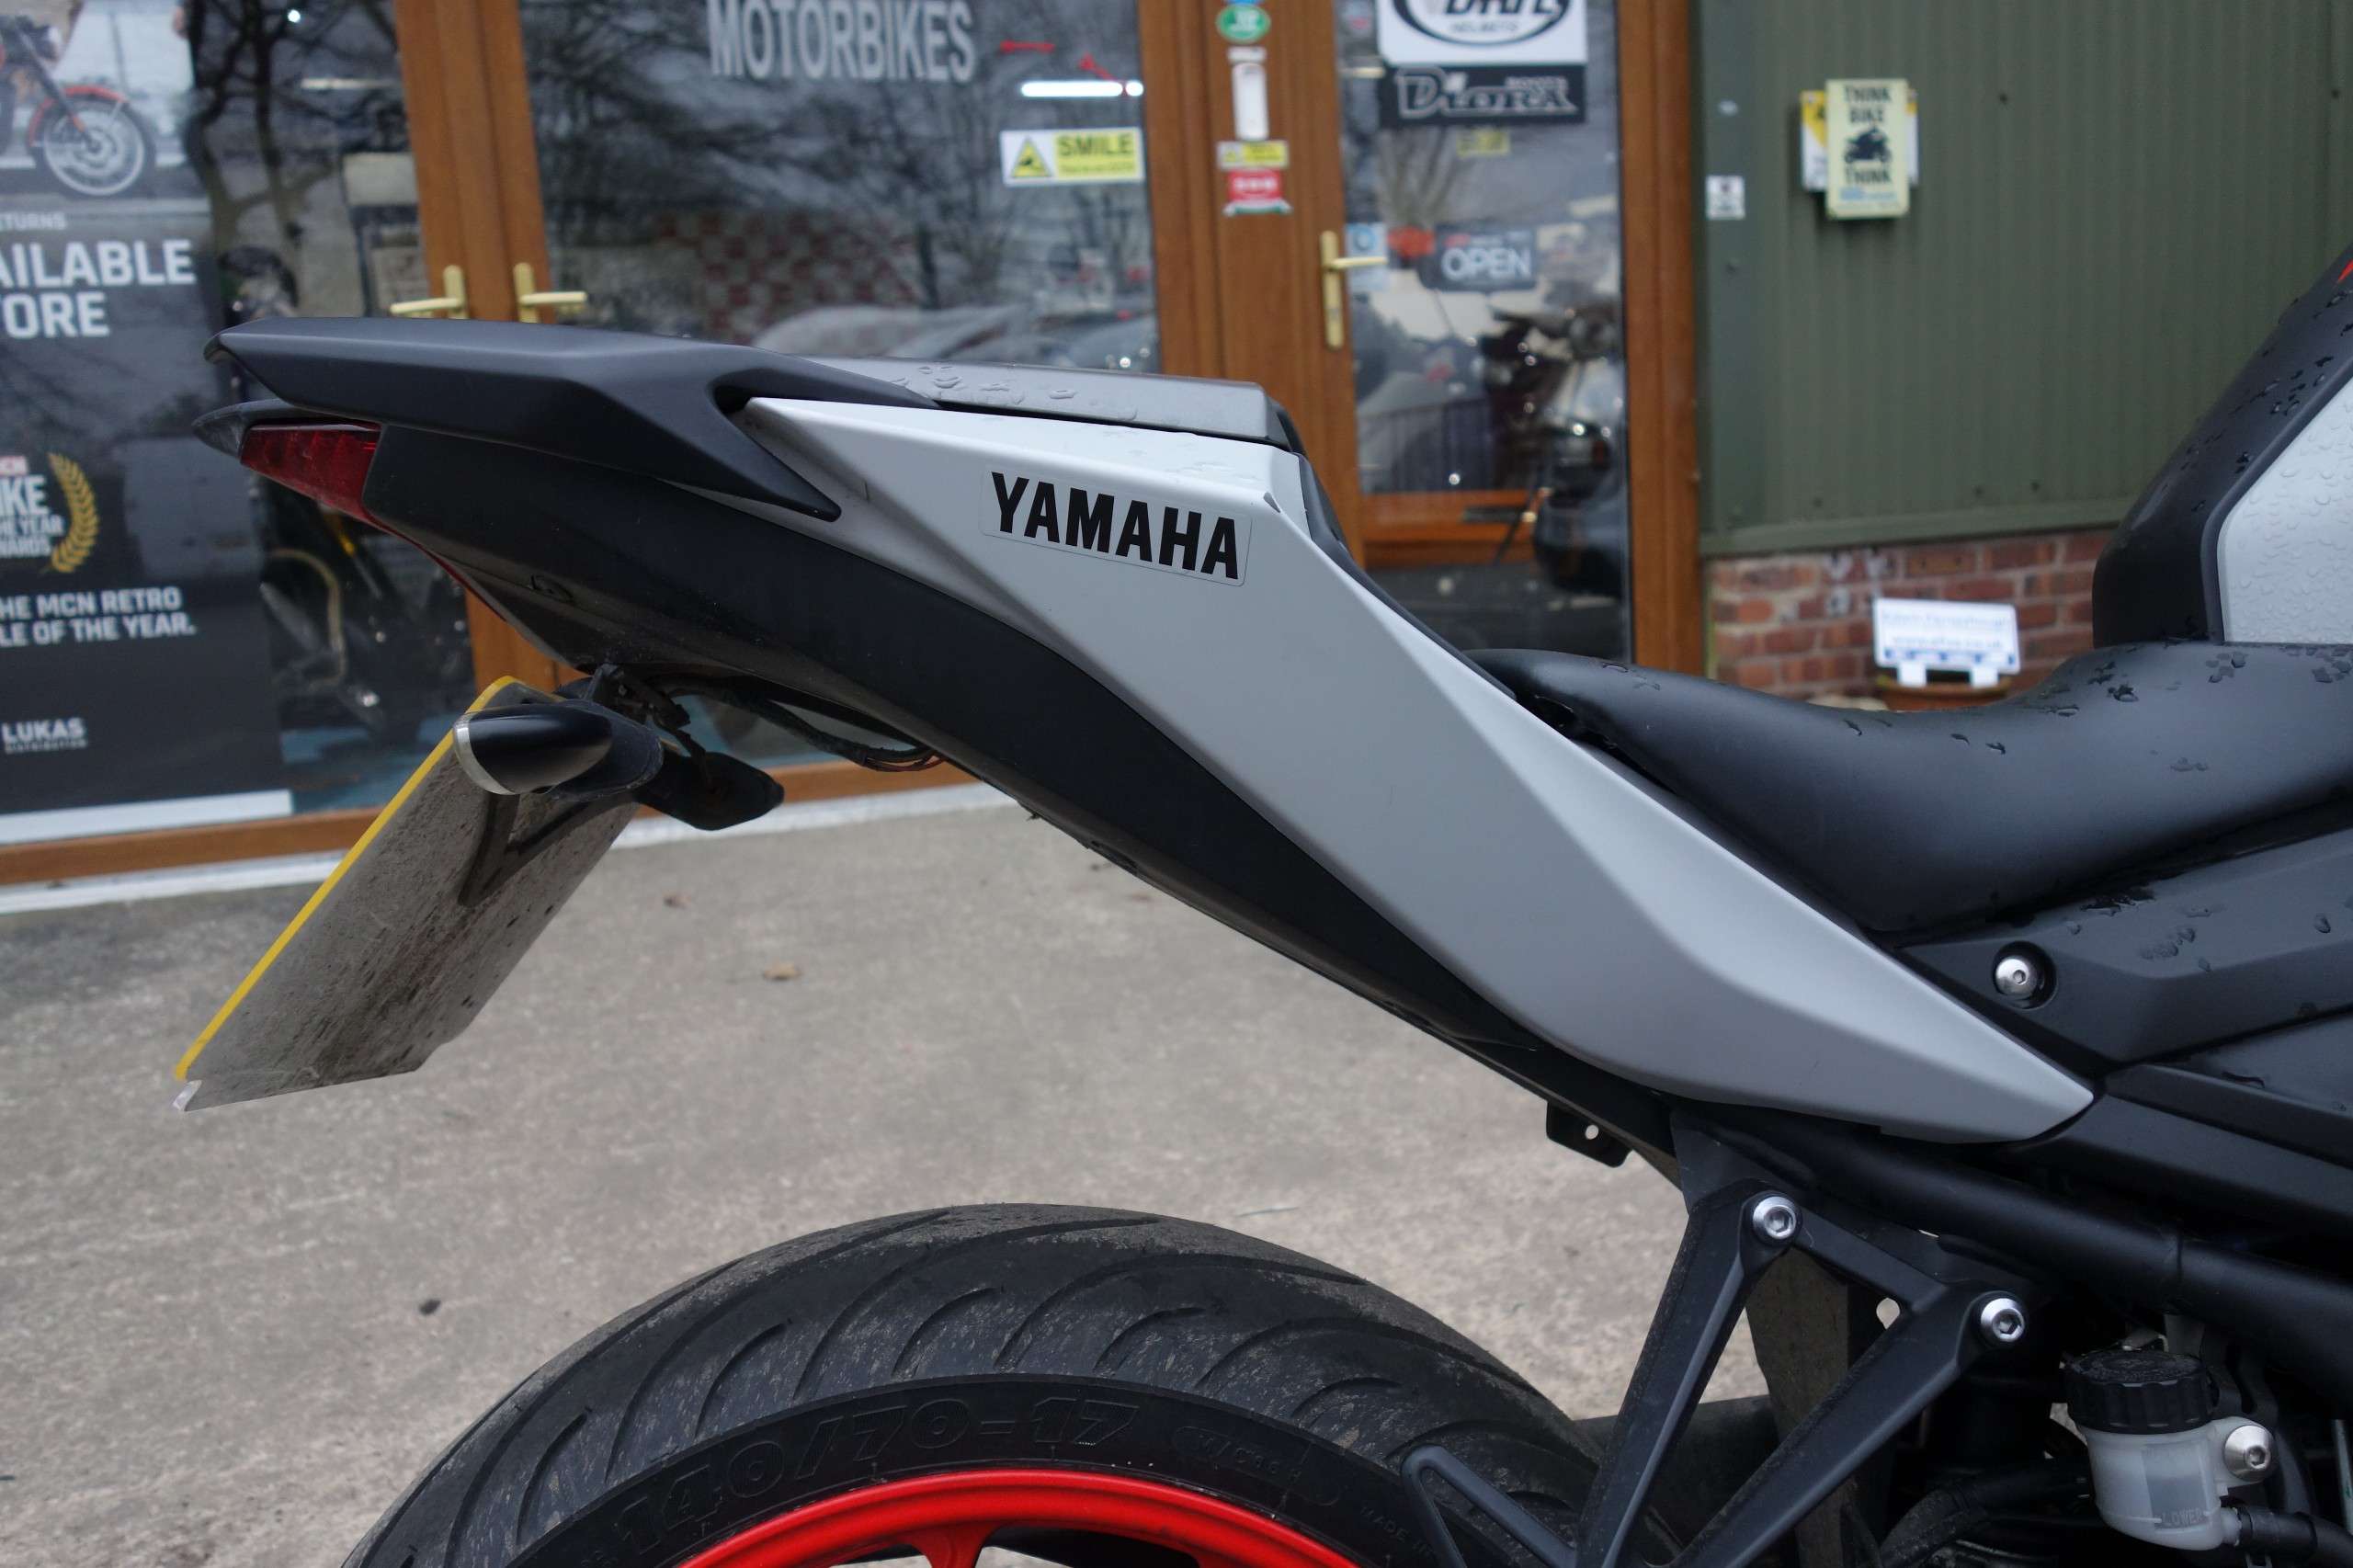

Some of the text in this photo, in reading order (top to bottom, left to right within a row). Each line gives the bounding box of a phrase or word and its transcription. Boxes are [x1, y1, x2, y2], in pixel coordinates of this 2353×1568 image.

[706, 0, 974, 82] MOTORBIKES
[1844, 85, 1891, 104] THINK
[1850, 106, 1884, 123] BIKE
[1059, 132, 1135, 156] SMILE
[1845, 166, 1892, 184] THINK
[1441, 247, 1531, 280] OPEN
[0, 290, 109, 339] ORE
[991, 471, 1239, 580] YAMAHA
[36, 592, 97, 618] MCN
[100, 586, 182, 613] RETRO
[32, 619, 64, 645] OF
[69, 616, 119, 642] THE
[121, 611, 197, 639] YEAR.
[2, 717, 85, 742] LUKAS
[613, 1397, 1141, 1555] 140/70-17
[2161, 1507, 2207, 1527] LOWER
